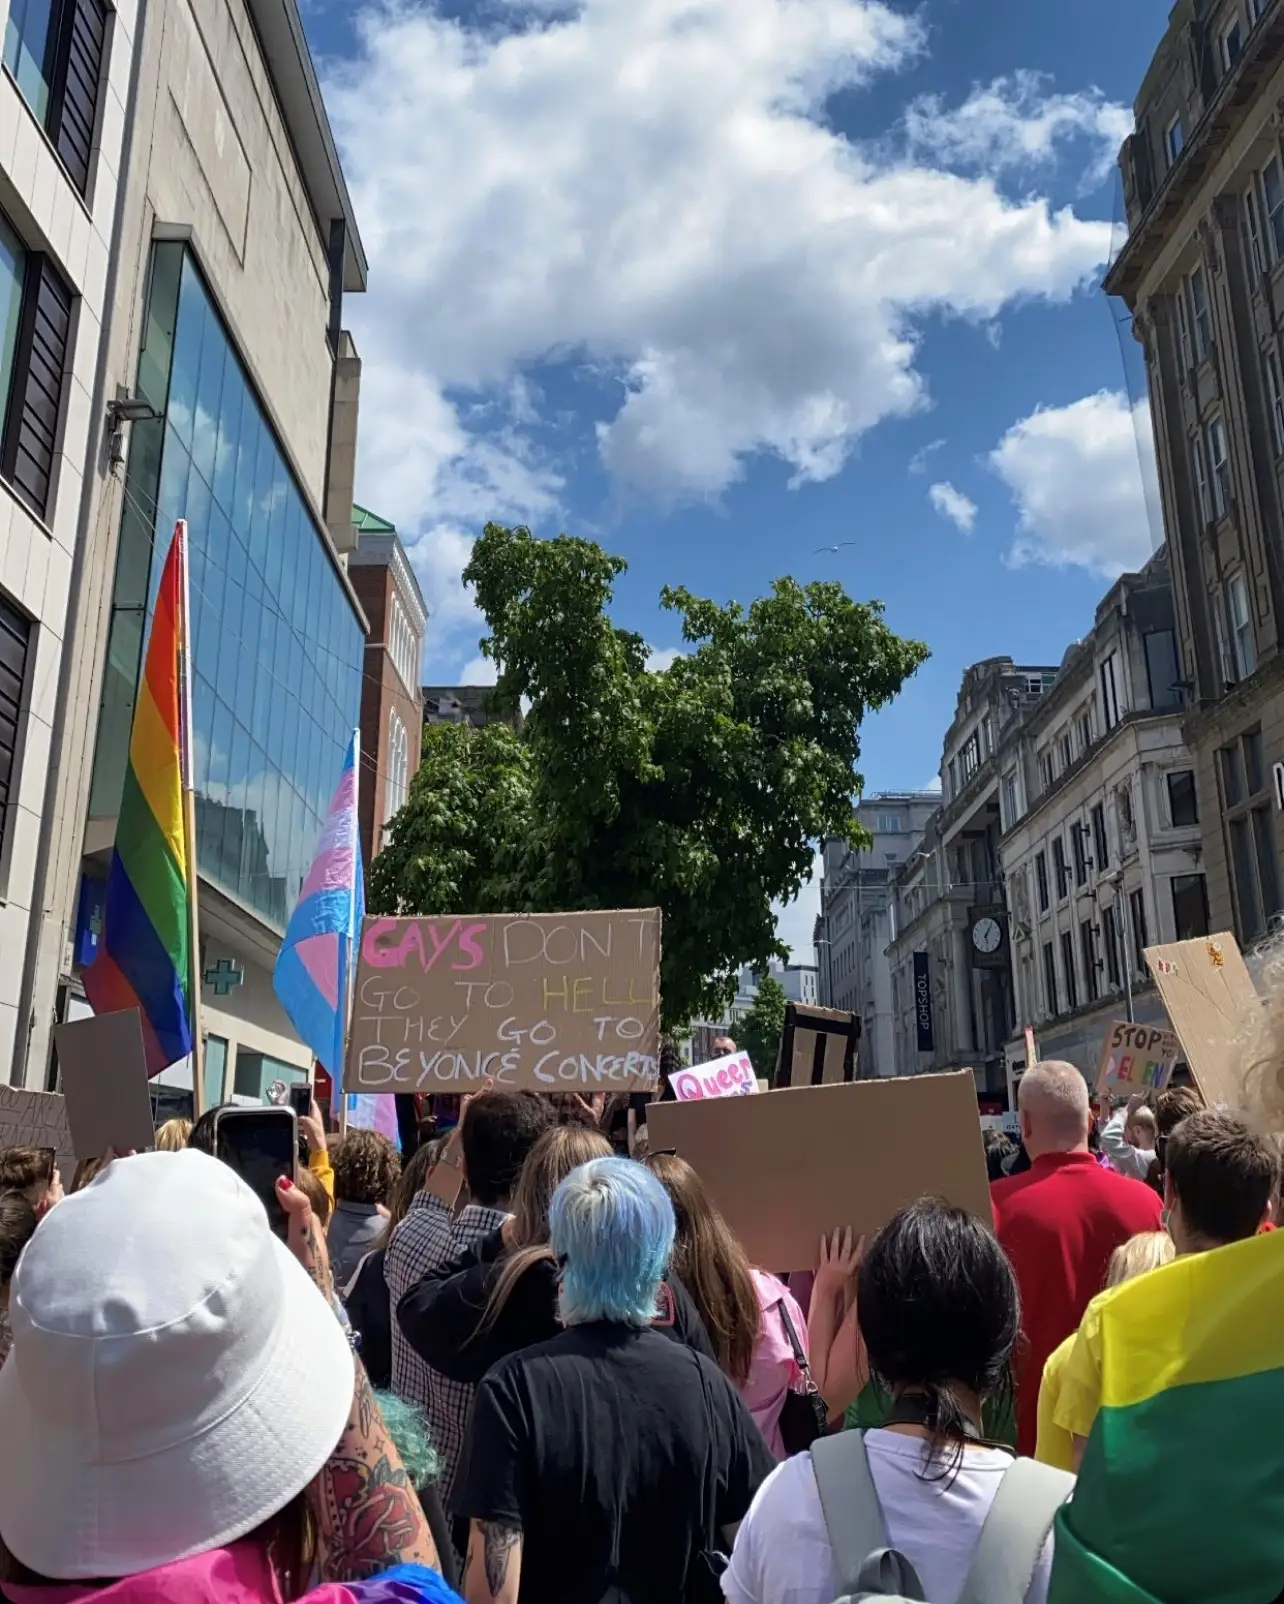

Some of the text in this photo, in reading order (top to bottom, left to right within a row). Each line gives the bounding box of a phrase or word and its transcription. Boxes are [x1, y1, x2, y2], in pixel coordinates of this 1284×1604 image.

[362, 918, 487, 973] GAYS
[361, 975, 655, 1013] GO TO HELL
[917, 973, 930, 1030] TOPSHOP
[359, 1015, 644, 1045] THEY GO TO
[1111, 1024, 1162, 1051] STOP
[358, 1044, 659, 1088] BEYONCÉ CONCERTS
[676, 1058, 751, 1100] Queer
